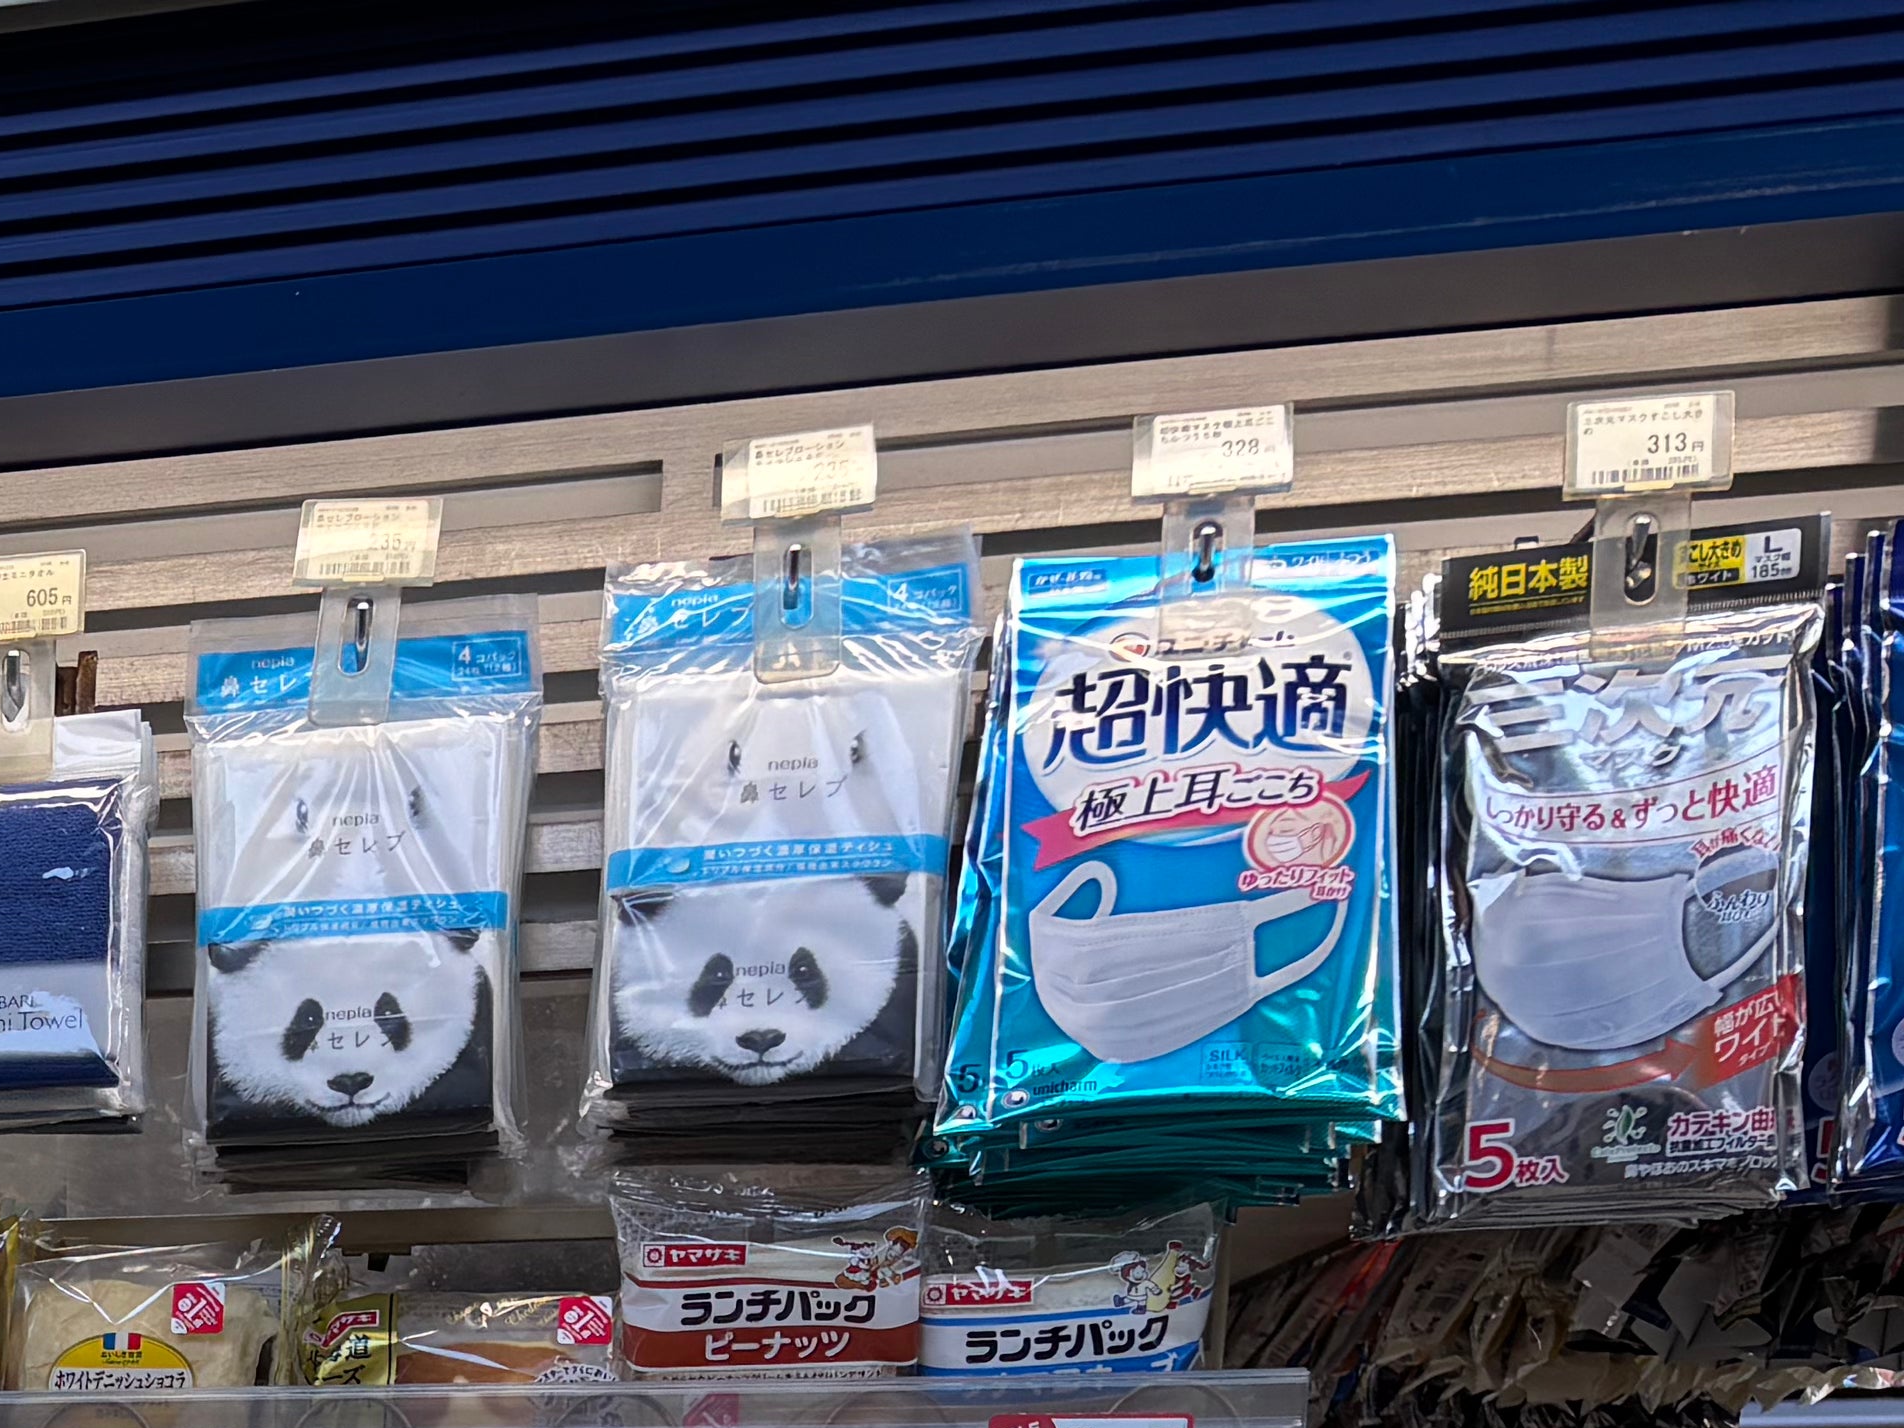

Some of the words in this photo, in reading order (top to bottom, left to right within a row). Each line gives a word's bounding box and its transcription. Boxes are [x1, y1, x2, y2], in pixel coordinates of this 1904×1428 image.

[1468, 553, 1592, 598] 純日本製
[25, 587, 72, 607] 605円
[1042, 652, 1352, 774] 超快適
[767, 755, 819, 774] nepia
[738, 776, 847, 804] 鼻セレブ
[1076, 767, 1322, 834] 極上耳ごこち
[332, 811, 380, 829] nepia
[17, 1009, 84, 1032] Towel
[680, 1290, 876, 1327] ランチパック
[703, 1330, 850, 1362] ピーナッツ
[965, 1315, 1170, 1364] ランチパック
